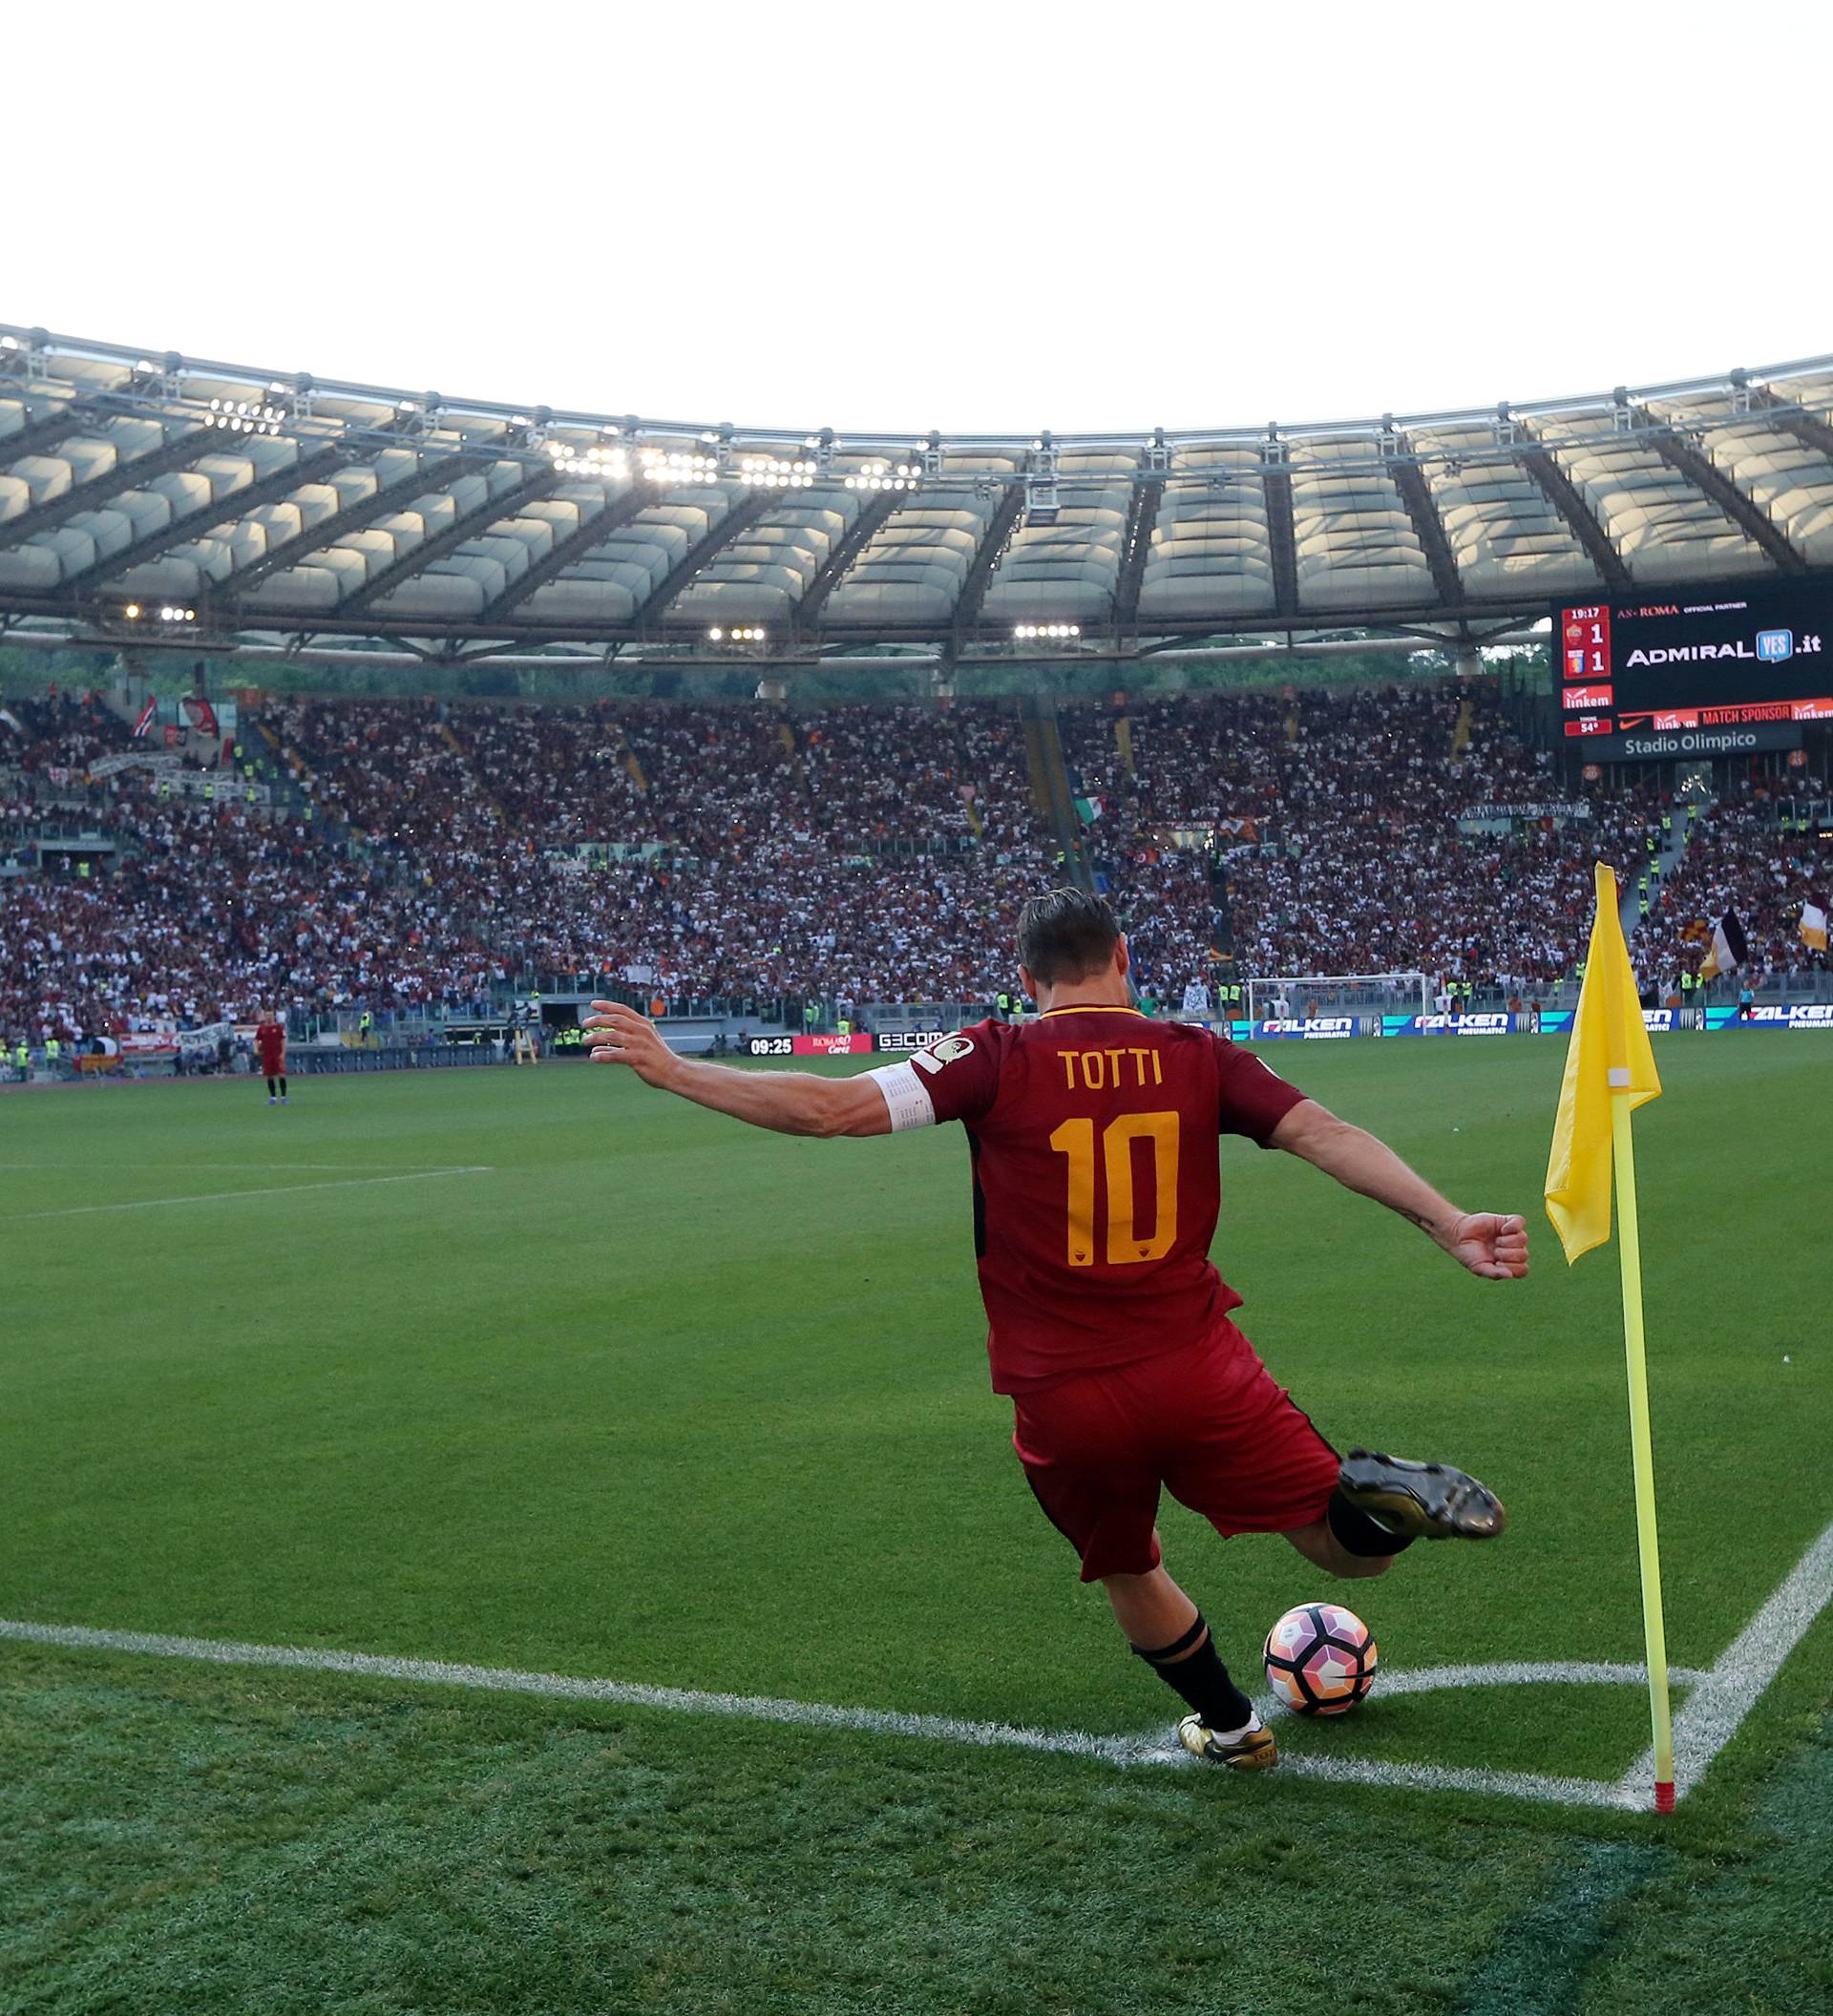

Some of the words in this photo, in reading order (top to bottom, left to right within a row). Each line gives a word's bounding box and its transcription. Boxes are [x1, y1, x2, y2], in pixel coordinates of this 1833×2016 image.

[1571, 607, 1600, 620] 19:17
[1639, 604, 1679, 618] ROMA
[1683, 605, 1715, 614] OFFICIAL
[1715, 601, 1747, 611] PARTNER
[1591, 623, 1604, 643] 1
[1591, 651, 1605, 671] 1
[1626, 641, 1755, 667] ADMIRAL
[1566, 691, 1610, 708] linkem
[1702, 709, 1739, 724] MATCH
[1740, 705, 1791, 723] SPONSOR
[1625, 736, 1678, 755] Stadio
[1680, 731, 1757, 751] Olimpico
[1263, 1018, 1352, 1033] FALKEN
[1415, 1014, 1508, 1028] FALKEN
[1304, 1031, 1351, 1040] PNEUMATICI
[1457, 1027, 1506, 1036] PNEUMATICI
[750, 1039, 792, 1055] 09:25
[1057, 1048, 1163, 1090] TOTTI
[1049, 1111, 1180, 1267] 10
